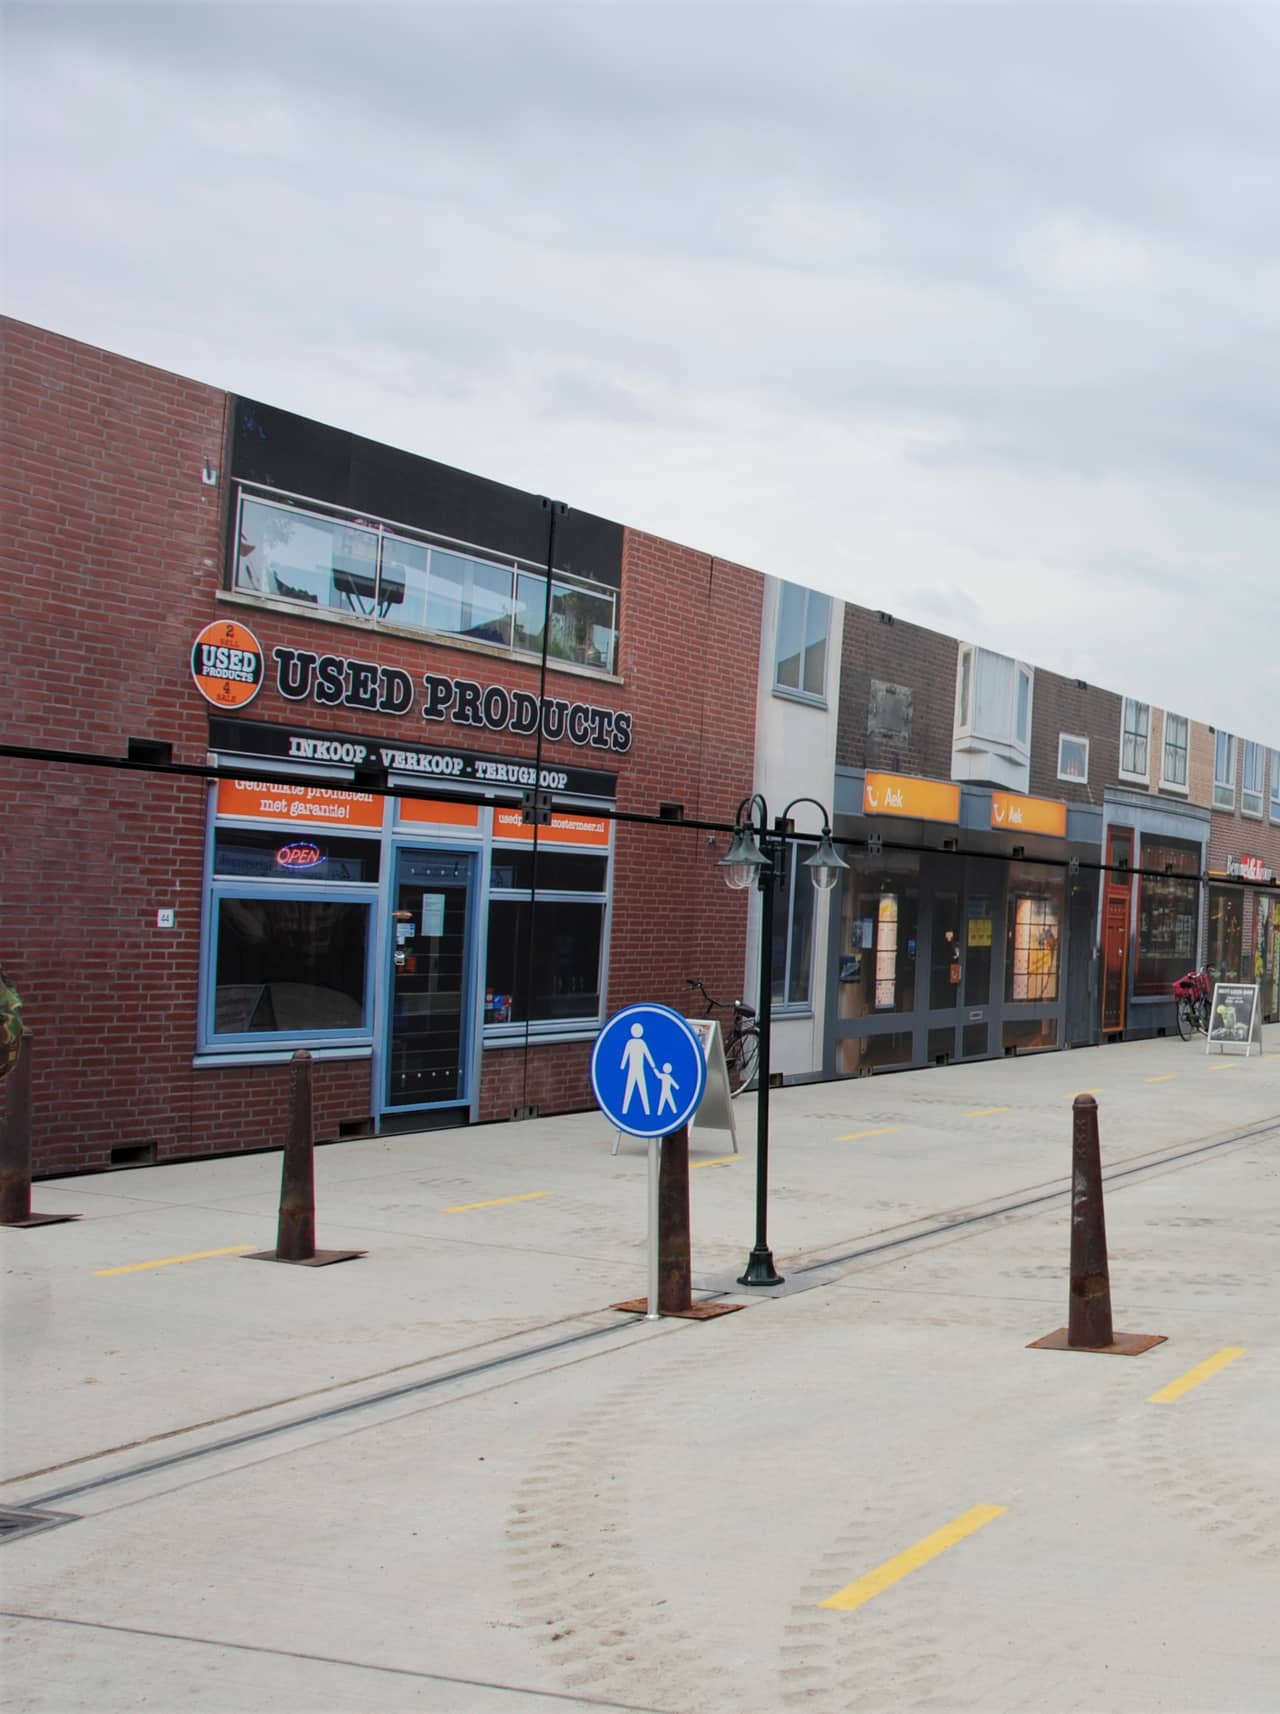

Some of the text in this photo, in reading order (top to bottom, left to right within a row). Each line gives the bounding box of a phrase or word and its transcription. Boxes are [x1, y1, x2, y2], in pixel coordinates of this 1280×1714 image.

[226, 625, 234, 638] 2
[202, 645, 256, 673] USED
[202, 666, 254, 682] PRODUCTS
[223, 682, 231, 694] 4
[272, 646, 633, 752] USED PRODUCTS
[288, 737, 367, 763] INKOOP
[380, 748, 464, 775] VERKOOP
[259, 799, 350, 818] met garantie!
[276, 847, 320, 865] OPEN
